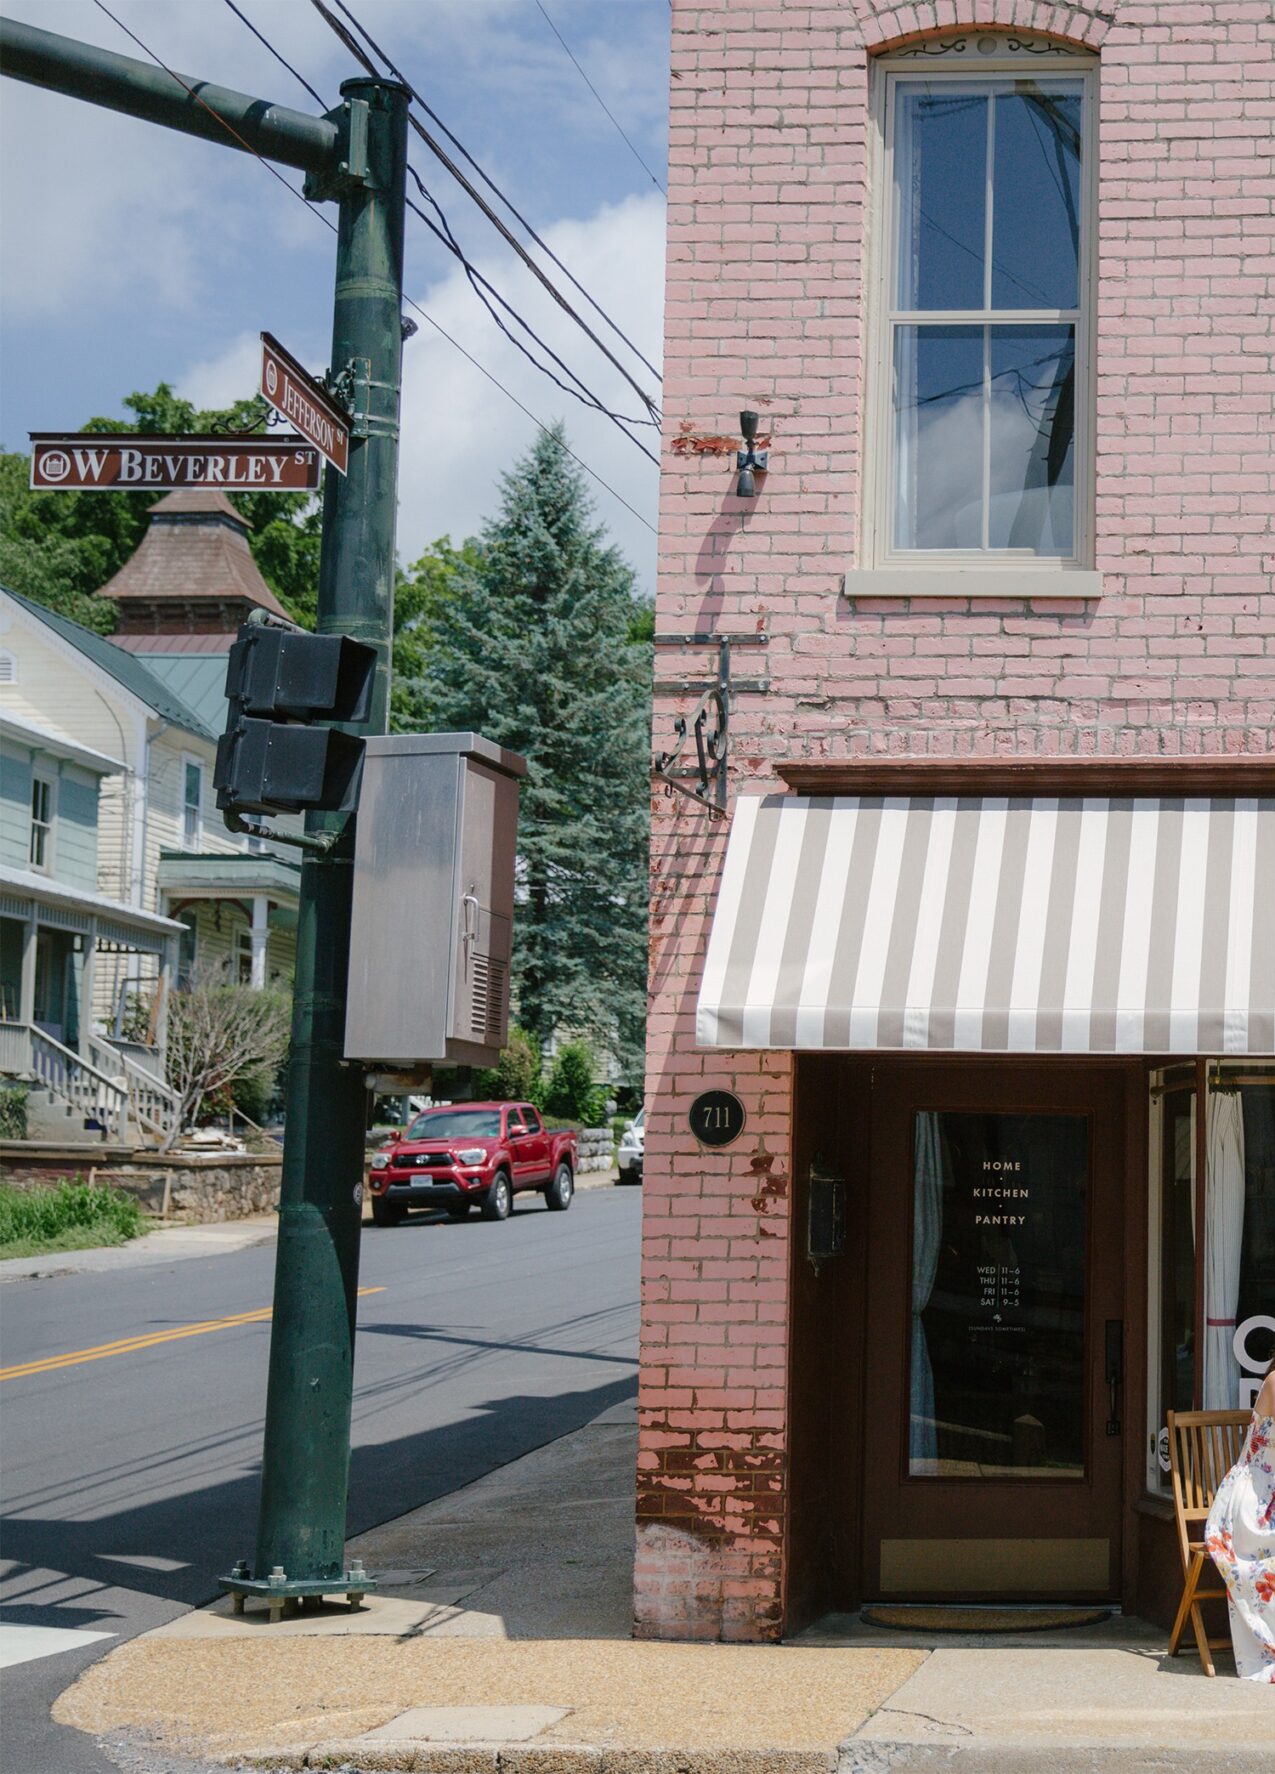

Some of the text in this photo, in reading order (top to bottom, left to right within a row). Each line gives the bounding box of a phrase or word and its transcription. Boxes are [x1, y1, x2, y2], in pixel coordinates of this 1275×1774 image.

[281, 374, 344, 454] JEFFERSON ST
[71, 448, 316, 483] W BEVERLEY ST
[703, 1106, 730, 1128] 711
[983, 1161, 1021, 1171] HOME
[973, 1188, 1029, 1198] KITCHEN
[975, 1215, 1025, 1225] PANTRY
[977, 1266, 996, 1274] WED
[980, 1277, 996, 1285] THU
[983, 1287, 996, 1295] FRI
[980, 1298, 996, 1306] SAT
